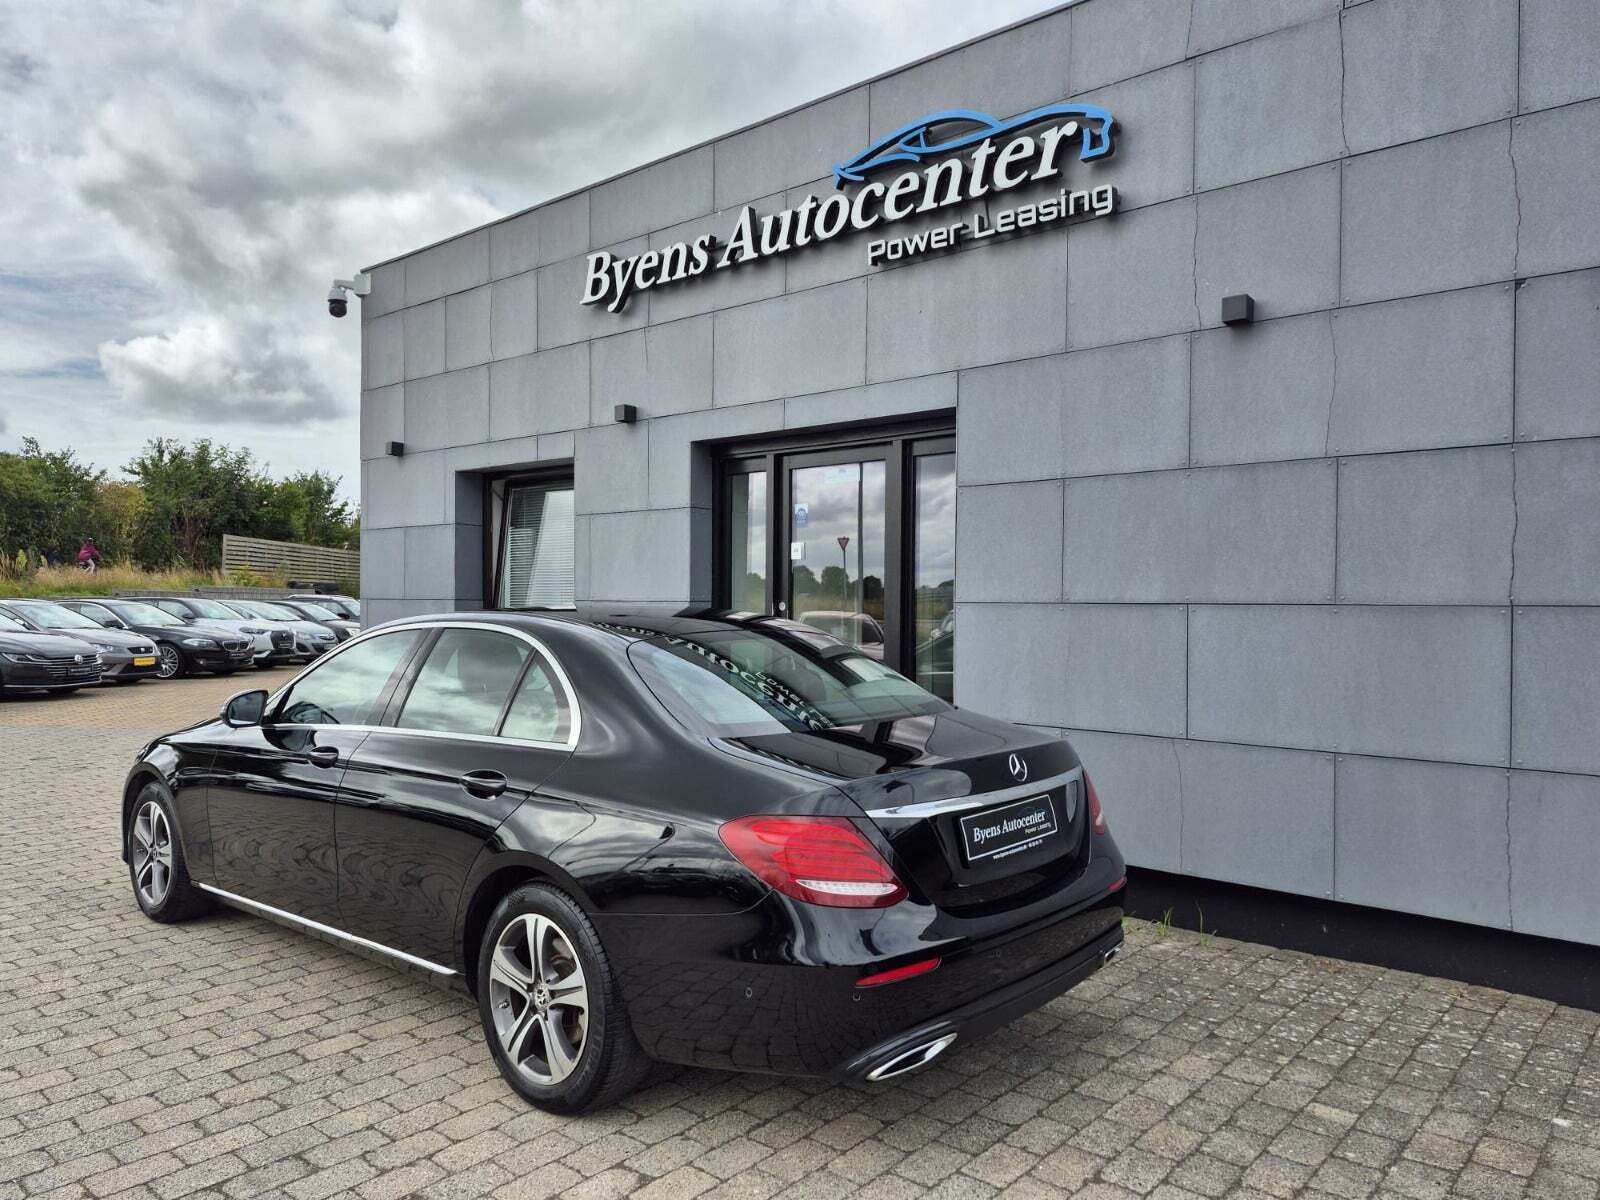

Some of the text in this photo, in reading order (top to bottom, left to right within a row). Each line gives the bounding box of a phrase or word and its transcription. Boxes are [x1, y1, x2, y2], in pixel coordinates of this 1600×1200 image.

[579, 120, 1078, 314] Byens Autocenter
[867, 183, 1114, 266] Power Leasing
[973, 811, 1046, 845] Byens Autocenter
